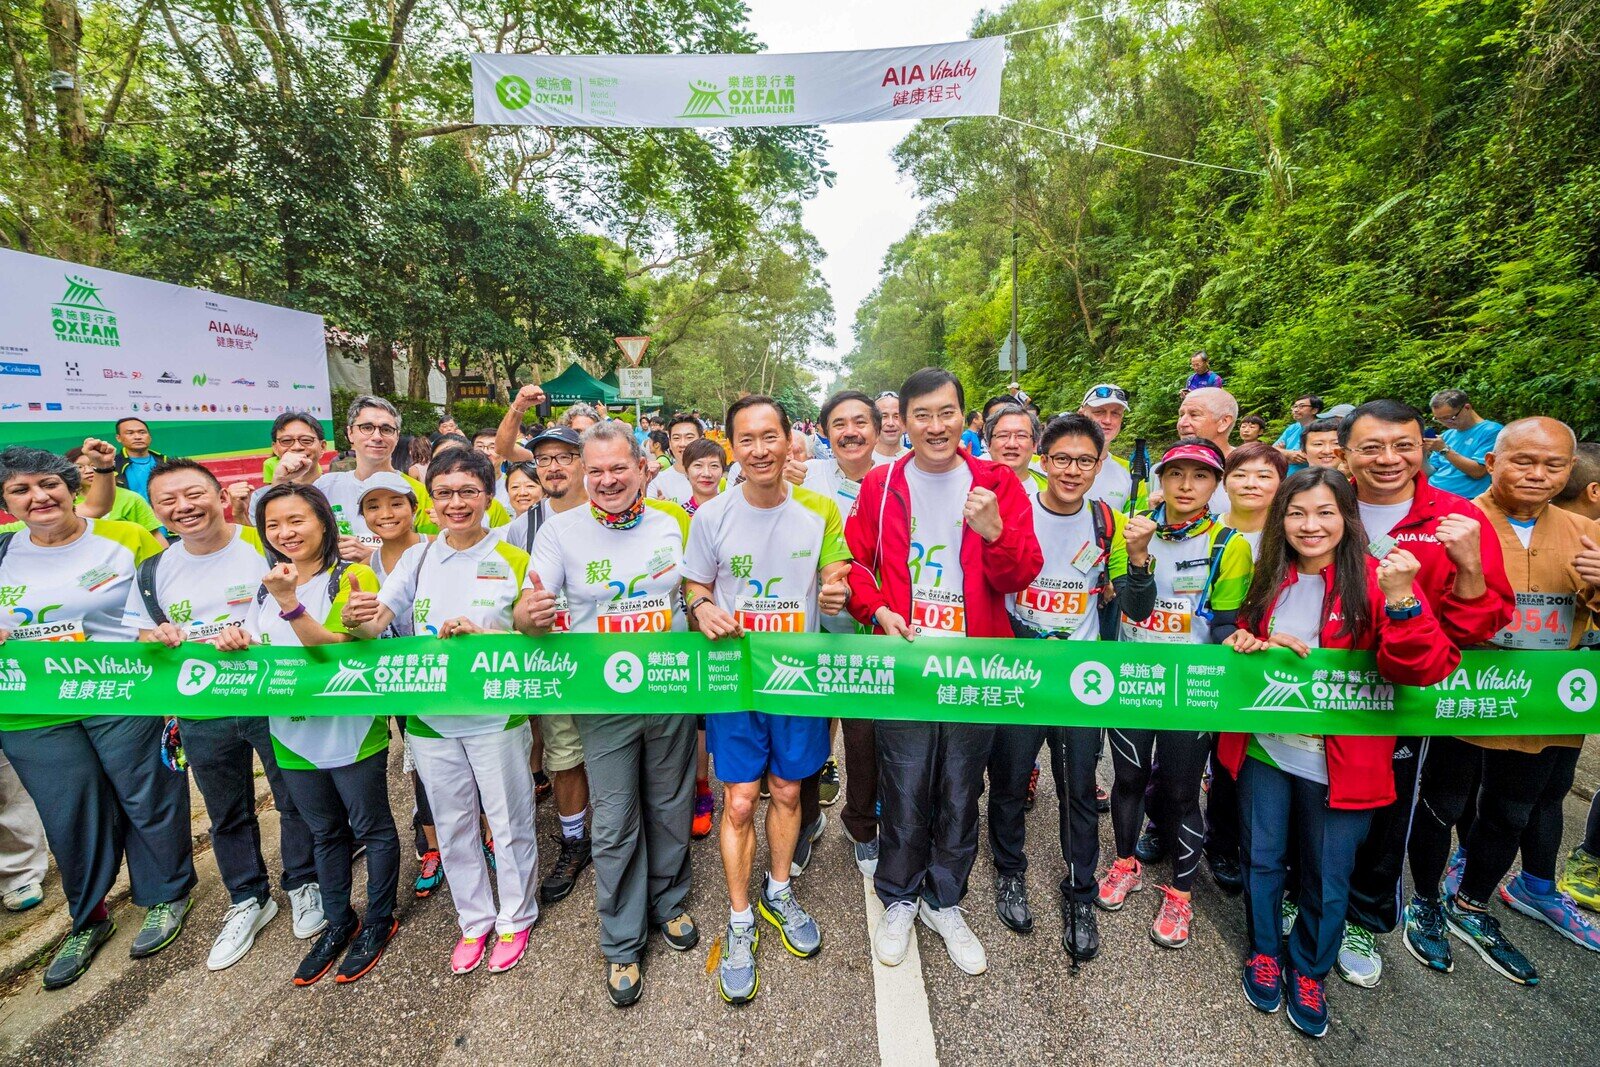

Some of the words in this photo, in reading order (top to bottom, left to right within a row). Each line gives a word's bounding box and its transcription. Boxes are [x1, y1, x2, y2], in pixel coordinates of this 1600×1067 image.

[881, 65, 925, 87] AIA
[930, 59, 977, 82] Vitality
[535, 77, 573, 91] 樂施會
[728, 76, 796, 88] 樂施毅行者
[535, 93, 573, 105] OXFAM
[590, 91, 609, 99] World
[728, 89, 795, 105] OXFAM
[893, 83, 961, 106] 健康程式
[730, 105, 795, 114] TRAILWALKER
[52, 319, 119, 339] OXFAM
[208, 320, 232, 334] AIA
[233, 324, 258, 341] Vitality
[55, 334, 121, 347] TRAILWALKER
[6, 365, 40, 374] Columbia
[268, 380, 279, 388] SGS
[1396, 533, 1418, 541] AIA
[586, 559, 612, 585] 毅
[730, 555, 753, 579] 毅
[1062, 581, 1084, 590] 2016
[642, 599, 664, 608] 2016
[951, 594, 964, 603] 20
[1021, 590, 1080, 614] L035
[1546, 597, 1574, 606] 2016
[777, 601, 799, 609] 2016
[1160, 600, 1184, 610] 2016
[169, 600, 192, 623] 毅
[42, 623, 75, 635] 2016
[218, 659, 258, 671] 樂施會
[377, 654, 449, 667] 樂施毅行者
[470, 651, 519, 673] AIA
[523, 648, 578, 679] Vitality
[647, 652, 690, 666] 樂施會
[817, 653, 896, 668] 樂施毅行者
[44, 657, 96, 674] AIA
[92, 655, 153, 681] Vitality
[273, 669, 295, 677] World
[708, 664, 730, 673] World
[921, 655, 977, 678] AIA
[980, 653, 1042, 689] Vitality
[1119, 663, 1166, 679] 樂施會
[215, 673, 257, 686] OXFAM
[374, 667, 448, 683] OXFAM
[647, 669, 690, 682] OXFAM
[708, 674, 739, 682] Without
[816, 667, 896, 684] OXFAM
[270, 677, 298, 686] Without
[1186, 678, 1211, 688] World
[1475, 665, 1532, 698] Vitality
[58, 679, 135, 701] 健康程式
[211, 686, 230, 696] Hong
[229, 686, 248, 697] Kong
[266, 686, 294, 697] Poverty
[375, 683, 447, 693] TRAILWALKER
[483, 678, 562, 700] 健康程式
[647, 684, 667, 694] Hong
[668, 684, 688, 694] Kong
[708, 683, 738, 693] Poverty
[817, 683, 895, 695] TRAILWALKER
[1119, 681, 1166, 696] OXFAM
[1186, 688, 1220, 698] Without
[1311, 682, 1395, 701] OXFAM
[936, 684, 1025, 708] 健康程式
[1119, 697, 1140, 708] Hong
[1142, 697, 1163, 709] Kong
[1186, 698, 1219, 710] Poverty
[1312, 699, 1394, 711] TRAILWALKER
[1435, 696, 1519, 719] 健康程式
